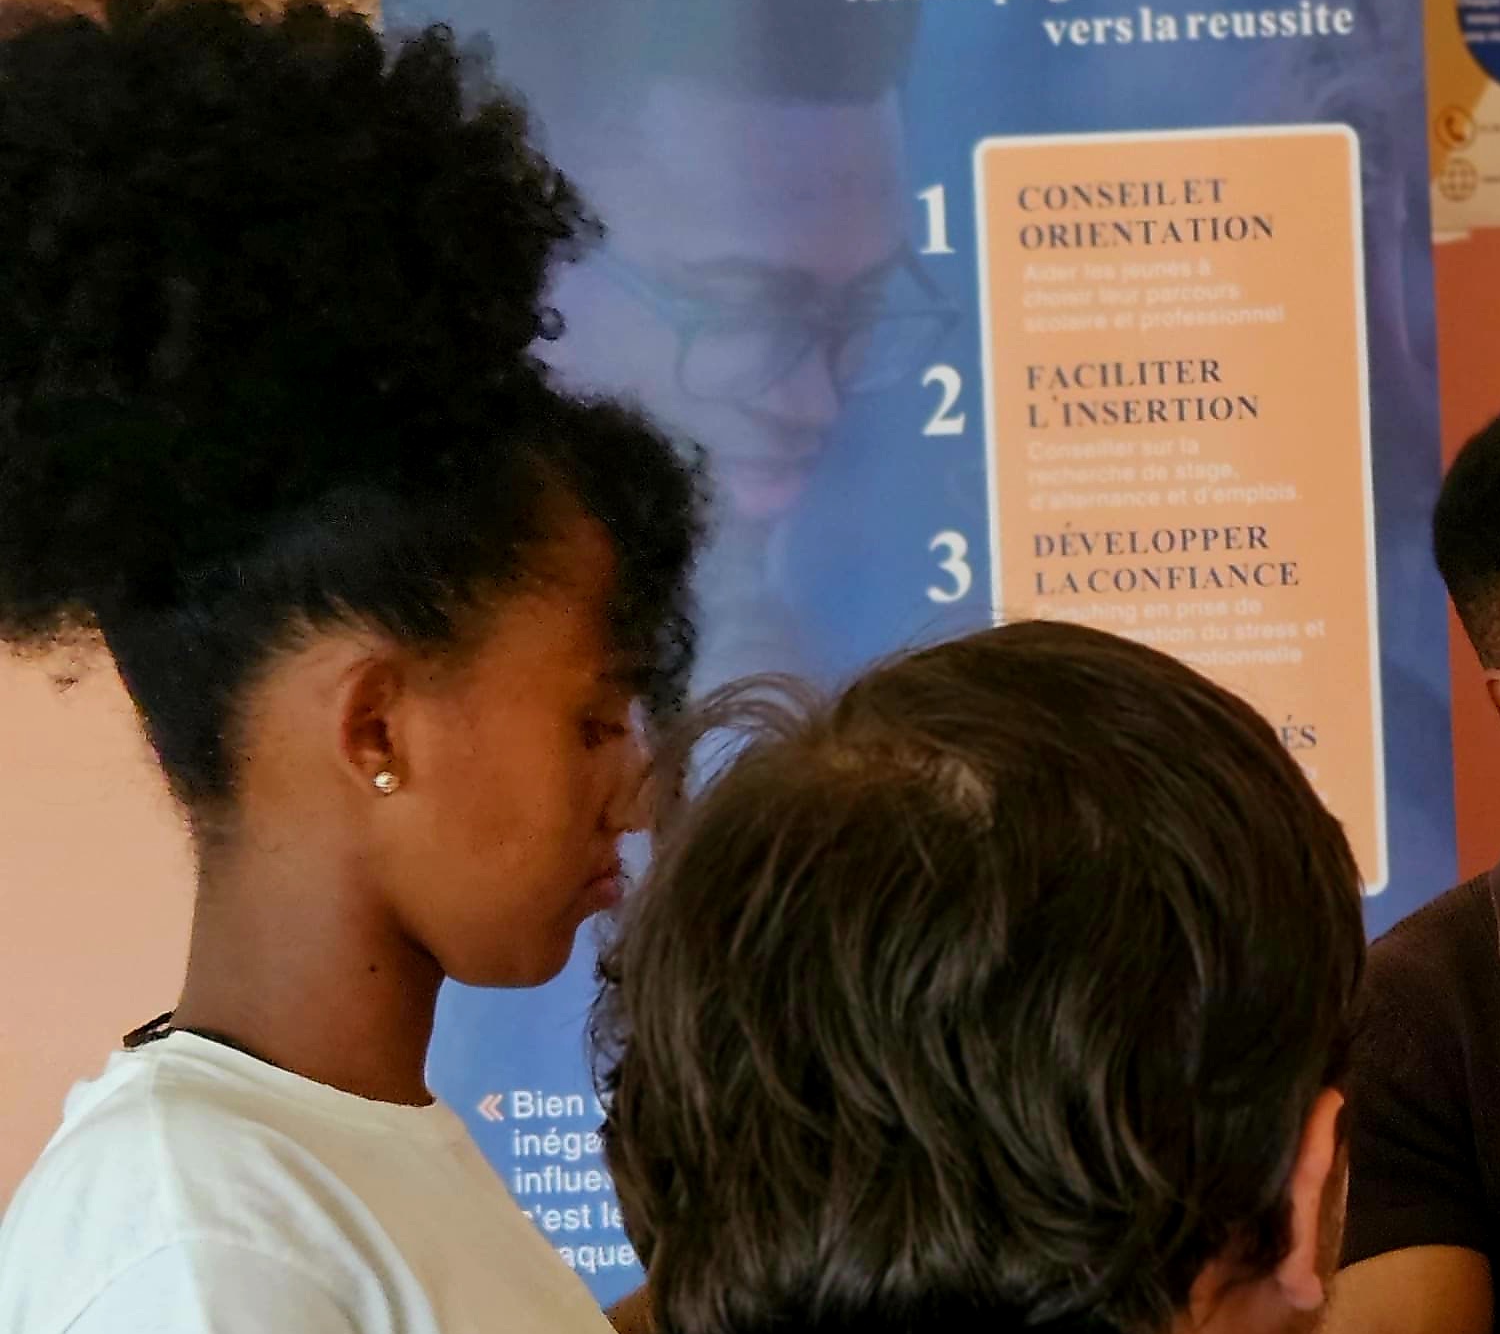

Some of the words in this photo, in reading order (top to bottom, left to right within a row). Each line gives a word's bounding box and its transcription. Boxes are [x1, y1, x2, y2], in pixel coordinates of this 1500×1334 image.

[1042, 14, 1135, 47] vers
[1139, 5, 1179, 43] la
[1017, 180, 1178, 213] CONSEIL
[1183, 177, 1228, 205] ET
[916, 183, 957, 256] 1
[1018, 213, 1276, 252] ORIENTATION
[1026, 357, 1223, 392] FACILITER
[920, 365, 967, 436] 2
[1027, 394, 1261, 430] L'INSERTION
[1033, 521, 1270, 559] DÉVELOPPER
[926, 529, 973, 604] 3
[1034, 570, 1080, 596] LA
[1087, 560, 1300, 594] CONFIANCE
[512, 1090, 585, 1118] Bien
[513, 1126, 606, 1162] inéga
[513, 1165, 614, 1194] influe
[521, 1203, 593, 1232] 'est
[558, 1242, 636, 1275] aque
